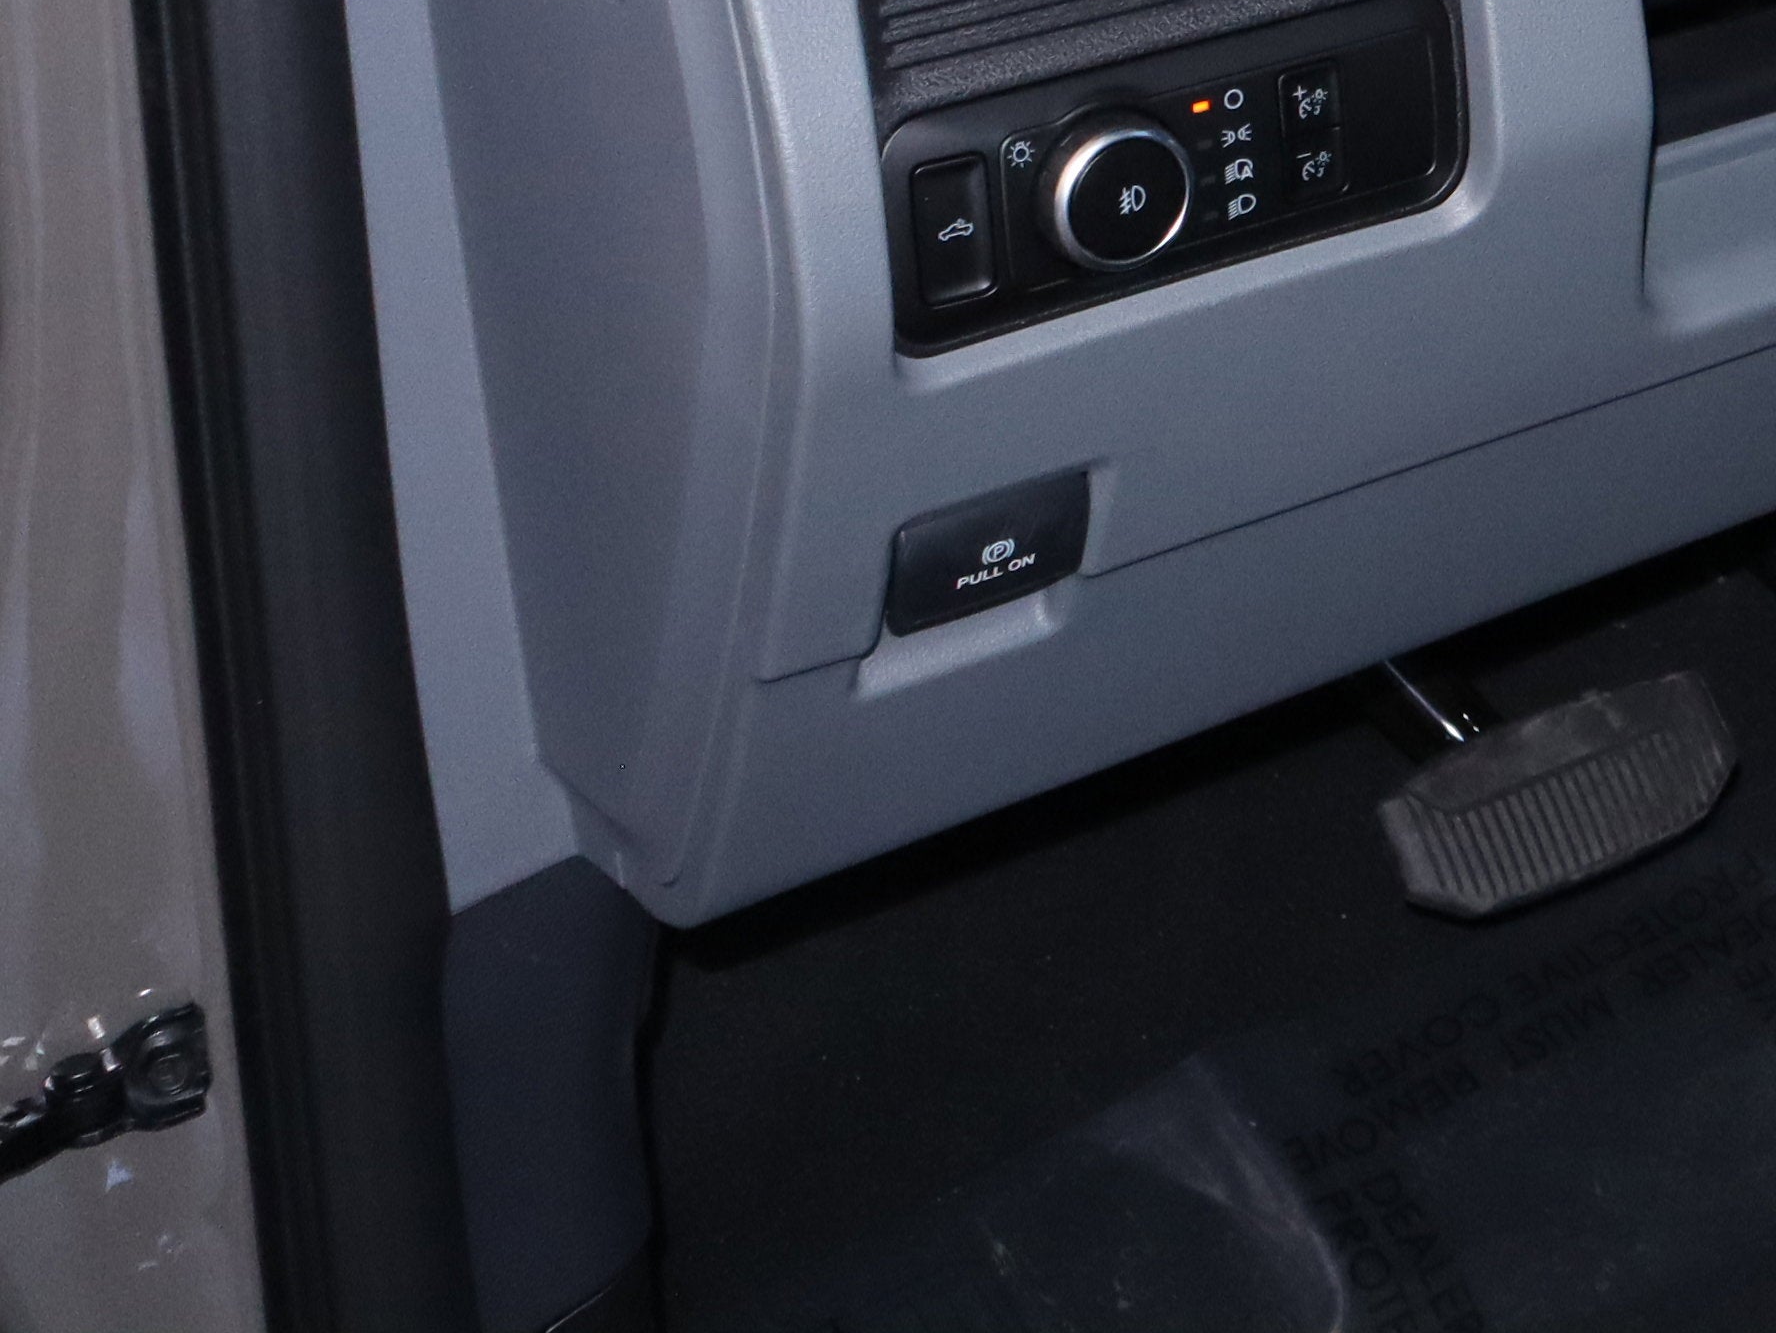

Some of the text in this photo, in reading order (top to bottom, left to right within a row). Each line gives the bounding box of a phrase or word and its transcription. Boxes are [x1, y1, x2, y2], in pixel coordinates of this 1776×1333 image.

[955, 553, 1036, 591] PULL ON
[1331, 849, 1766, 1099] PROTECTIVE COVER
[1501, 988, 1617, 1072] MUST
[1283, 1060, 1482, 1176] REMOVE
